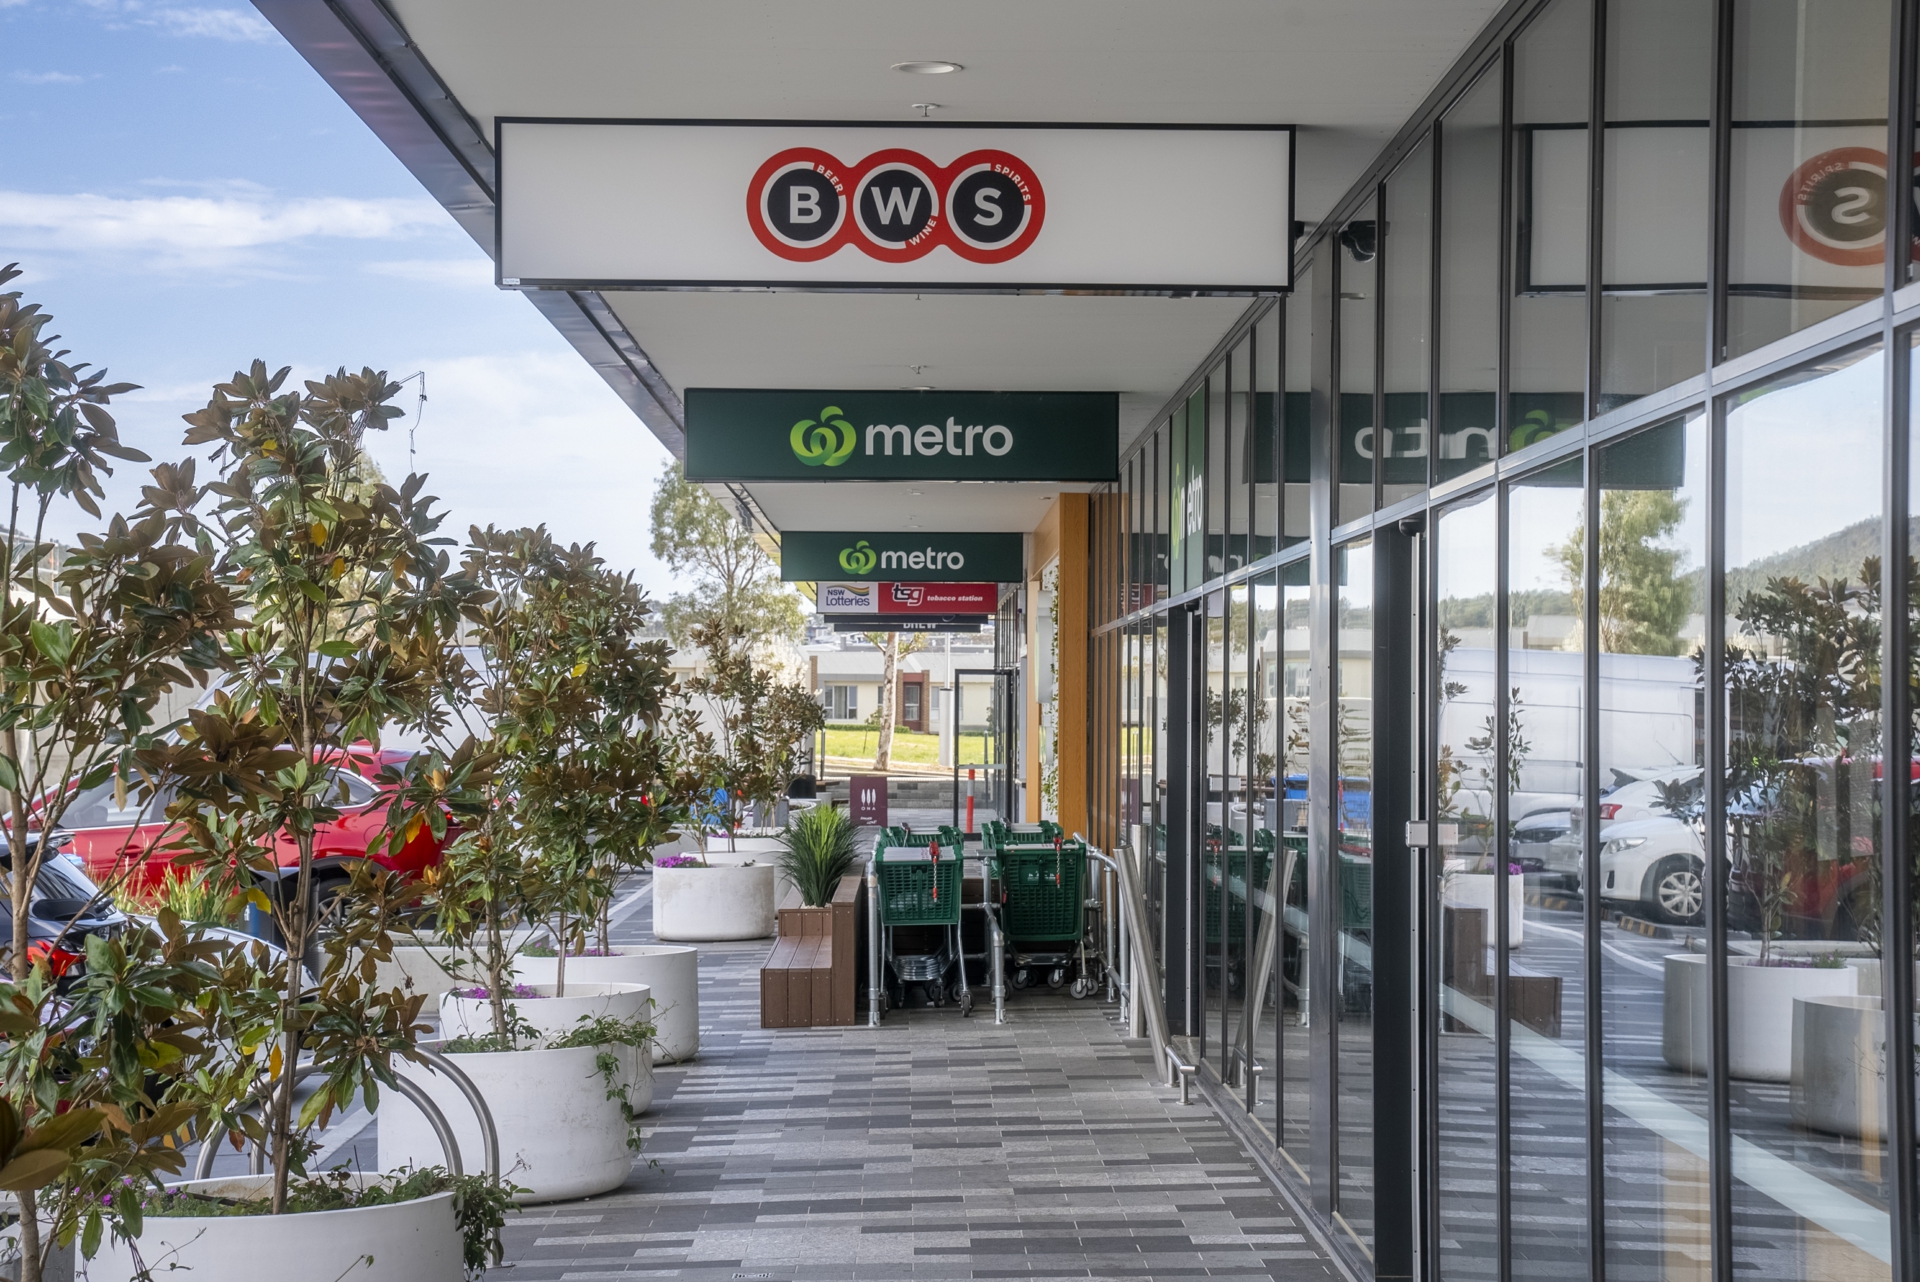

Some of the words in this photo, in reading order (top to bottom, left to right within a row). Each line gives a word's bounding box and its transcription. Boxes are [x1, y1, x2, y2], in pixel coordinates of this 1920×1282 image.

[816, 164, 844, 194] BEER
[994, 163, 1031, 202] SPIRITS
[908, 218, 937, 247] WINE
[865, 416, 1013, 456] metro
[881, 547, 964, 570] metro
[826, 596, 870, 607] Lotteries
[891, 582, 924, 607] tsg
